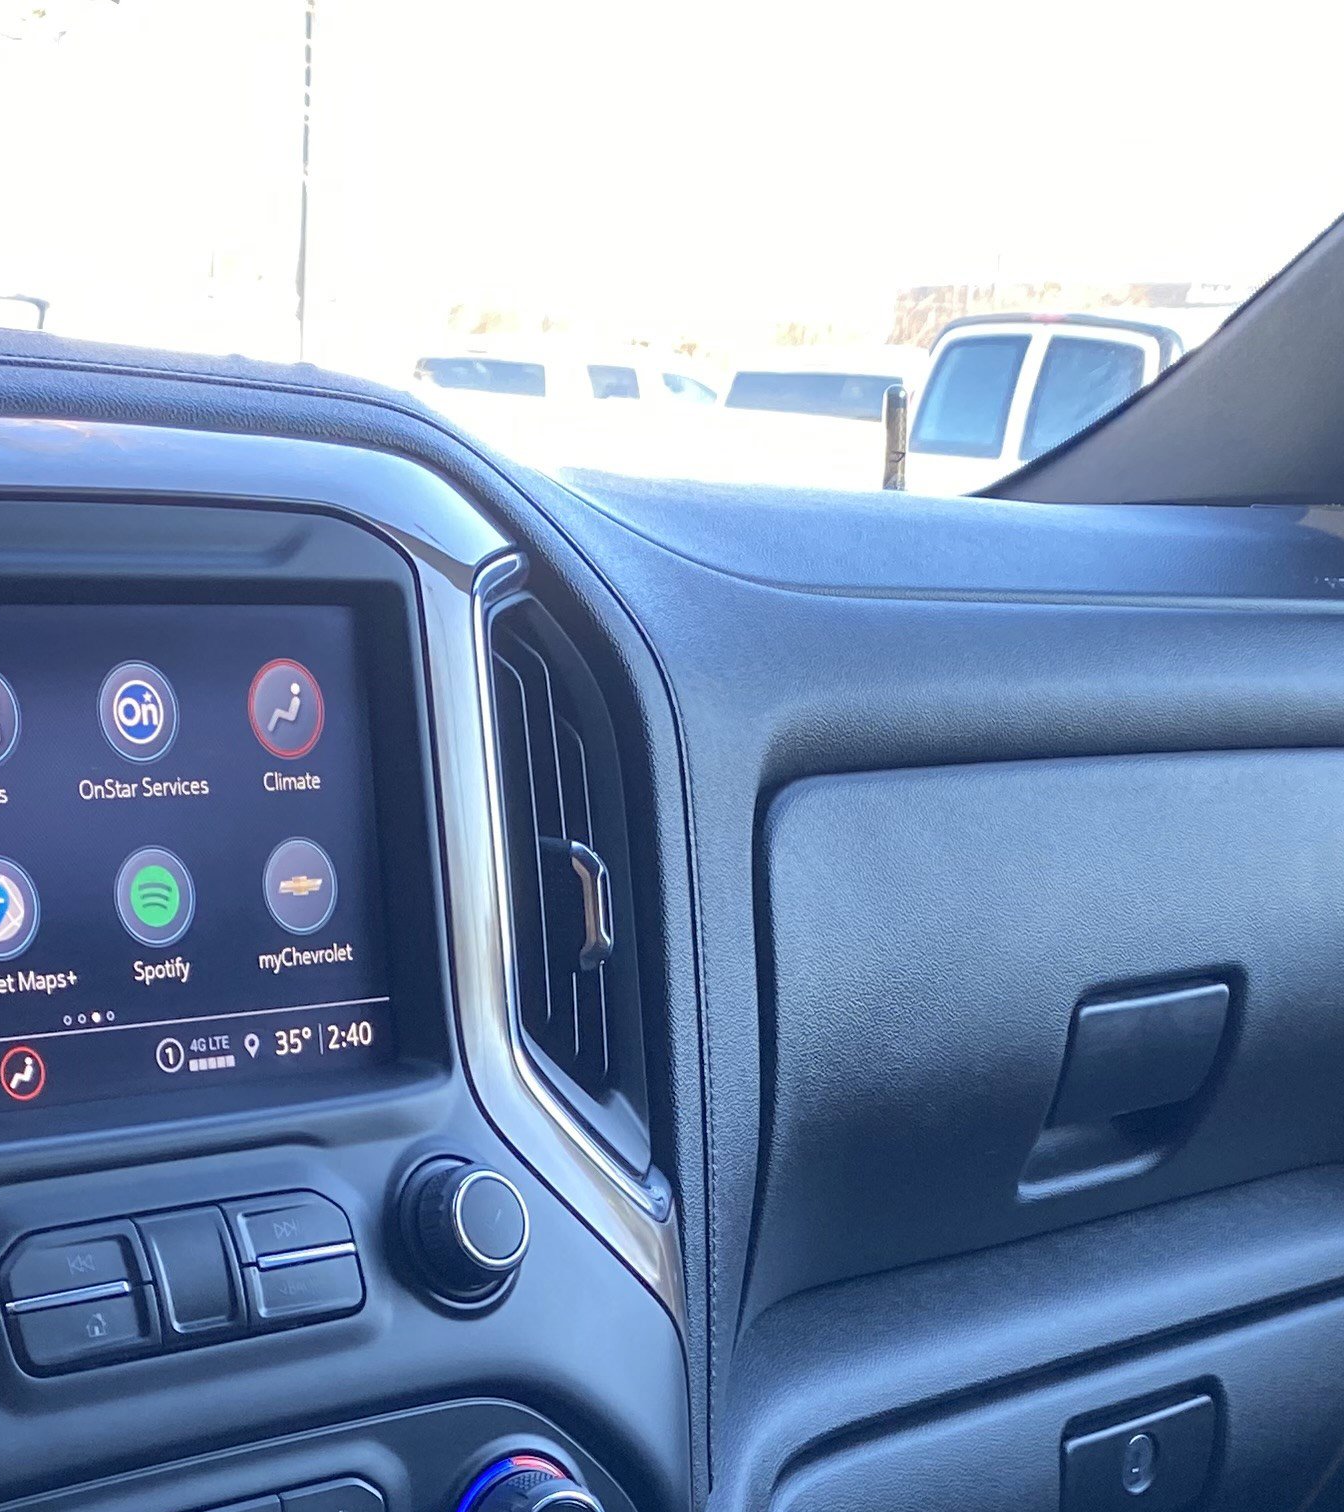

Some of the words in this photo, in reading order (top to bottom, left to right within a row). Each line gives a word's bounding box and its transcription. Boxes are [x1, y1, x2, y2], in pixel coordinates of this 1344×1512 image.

[78, 778, 138, 800] OnStar
[142, 776, 209, 798] Services
[263, 772, 321, 792] Climate
[133, 957, 190, 984] Spotify
[258, 943, 354, 974] myChevrolet
[18, 969, 78, 996] Maps+
[188, 1038, 207, 1053] 4G
[208, 1035, 230, 1051] LTE
[327, 1020, 373, 1050] 2:40
